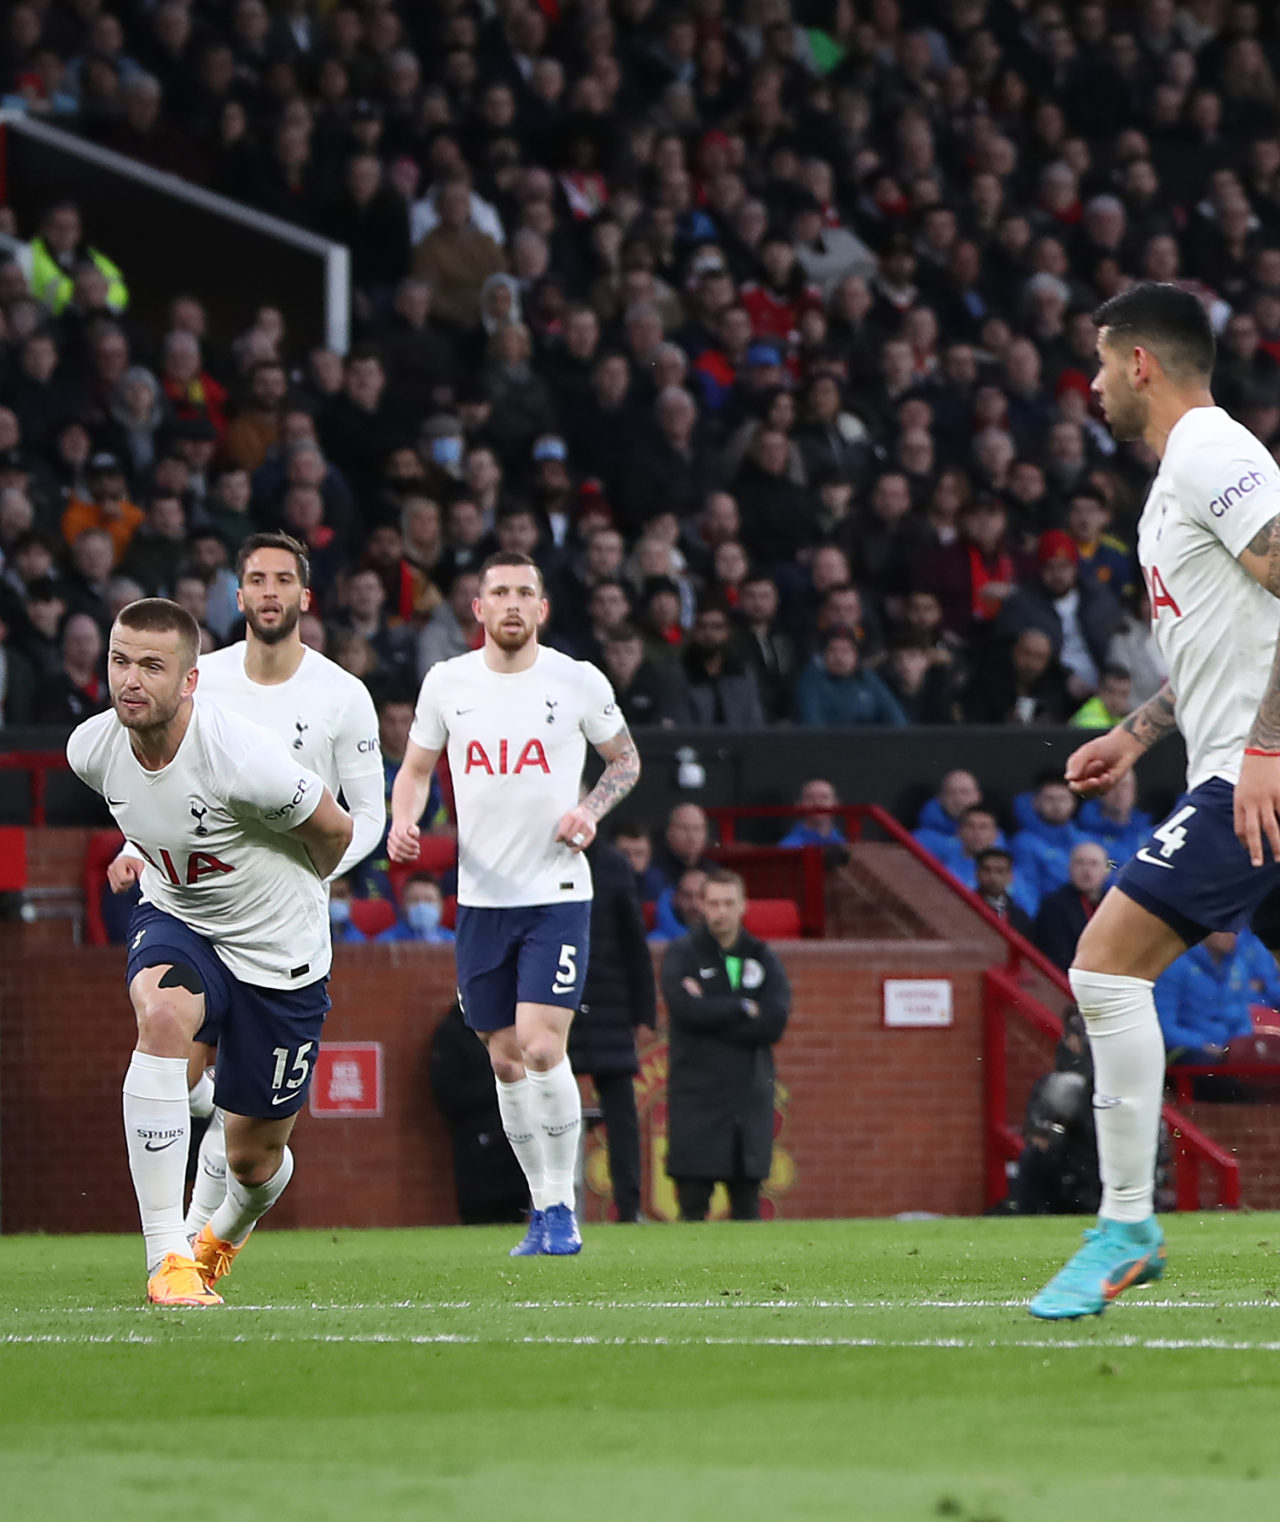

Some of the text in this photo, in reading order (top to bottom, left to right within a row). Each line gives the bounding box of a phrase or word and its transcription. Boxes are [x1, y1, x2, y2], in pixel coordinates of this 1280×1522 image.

[1209, 469, 1268, 518] cinch
[356, 738, 380, 753] cin
[464, 738, 551, 775] AIA
[1152, 805, 1197, 858] 4
[555, 943, 577, 985] 5
[271, 1041, 313, 1090] 15
[137, 1127, 184, 1140] SPURS
